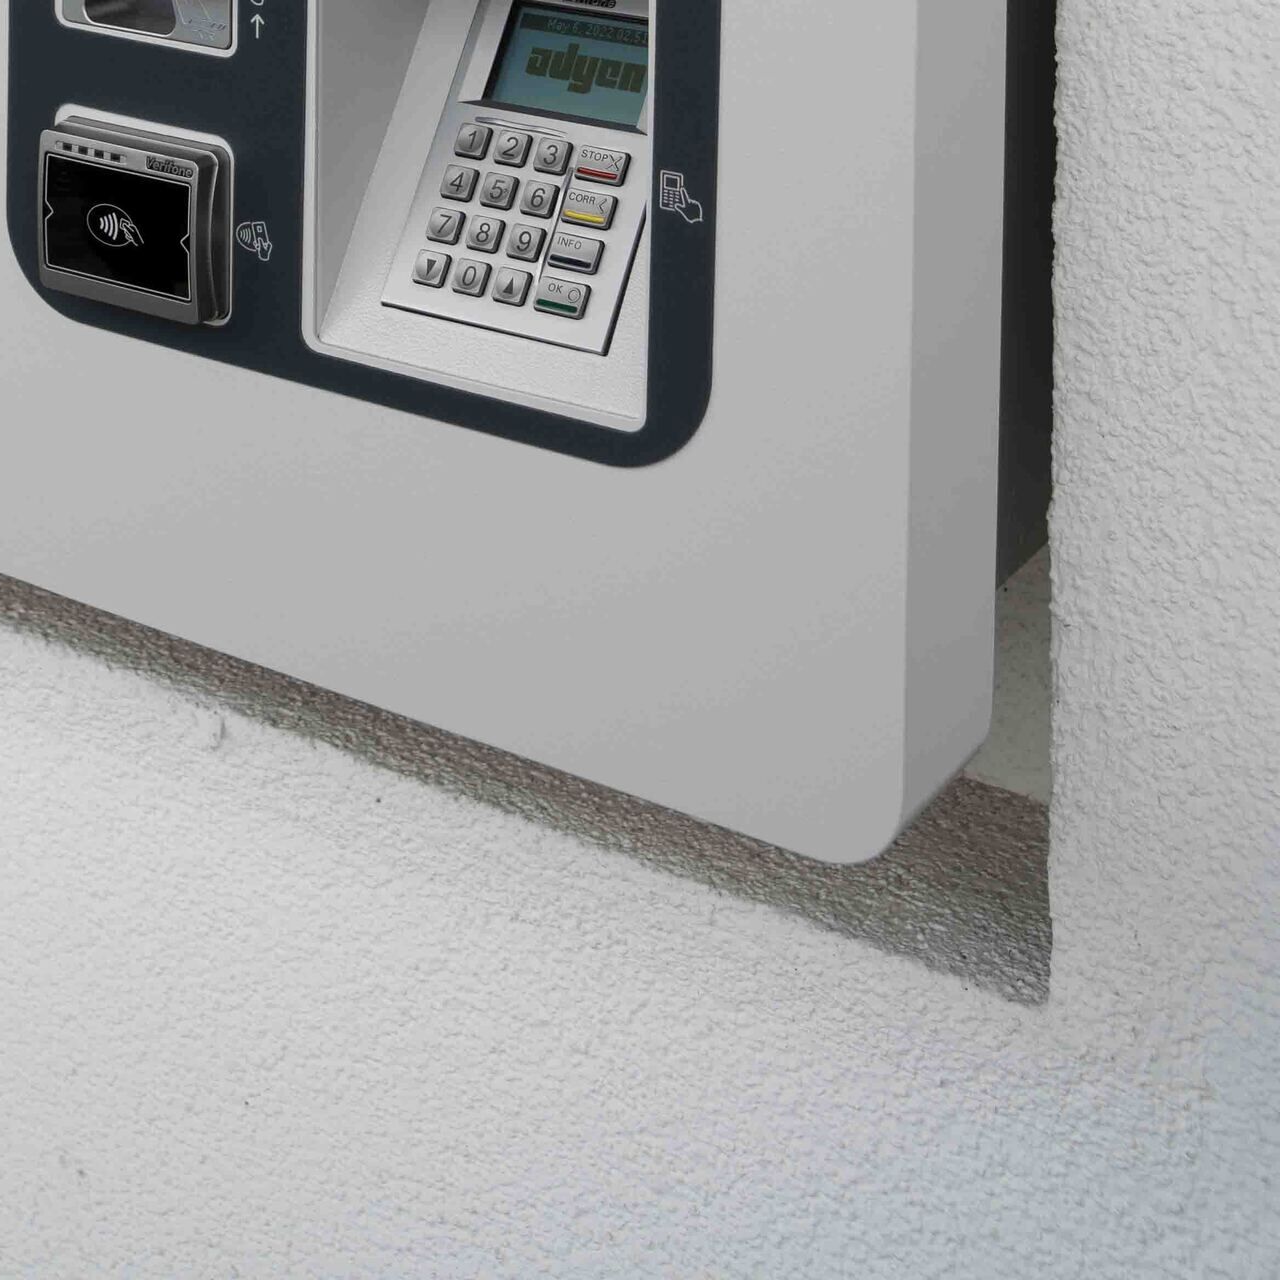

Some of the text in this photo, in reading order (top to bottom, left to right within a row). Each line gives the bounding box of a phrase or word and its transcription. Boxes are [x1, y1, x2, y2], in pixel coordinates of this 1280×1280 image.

[525, 43, 648, 95] adyen
[468, 129, 478, 150] 1
[502, 136, 519, 157] 2
[543, 144, 559, 165] 3
[580, 149, 609, 162] STOP
[146, 155, 194, 179] Verifone
[449, 171, 464, 192] 4
[489, 179, 505, 200] 5
[530, 187, 546, 208] 6
[568, 191, 596, 206] CORR
[439, 214, 452, 234] 7
[475, 222, 491, 243] 8
[516, 230, 532, 252] 9
[557, 236, 582, 250] INFO
[462, 265, 477, 286] 0
[547, 282, 563, 294] OK
